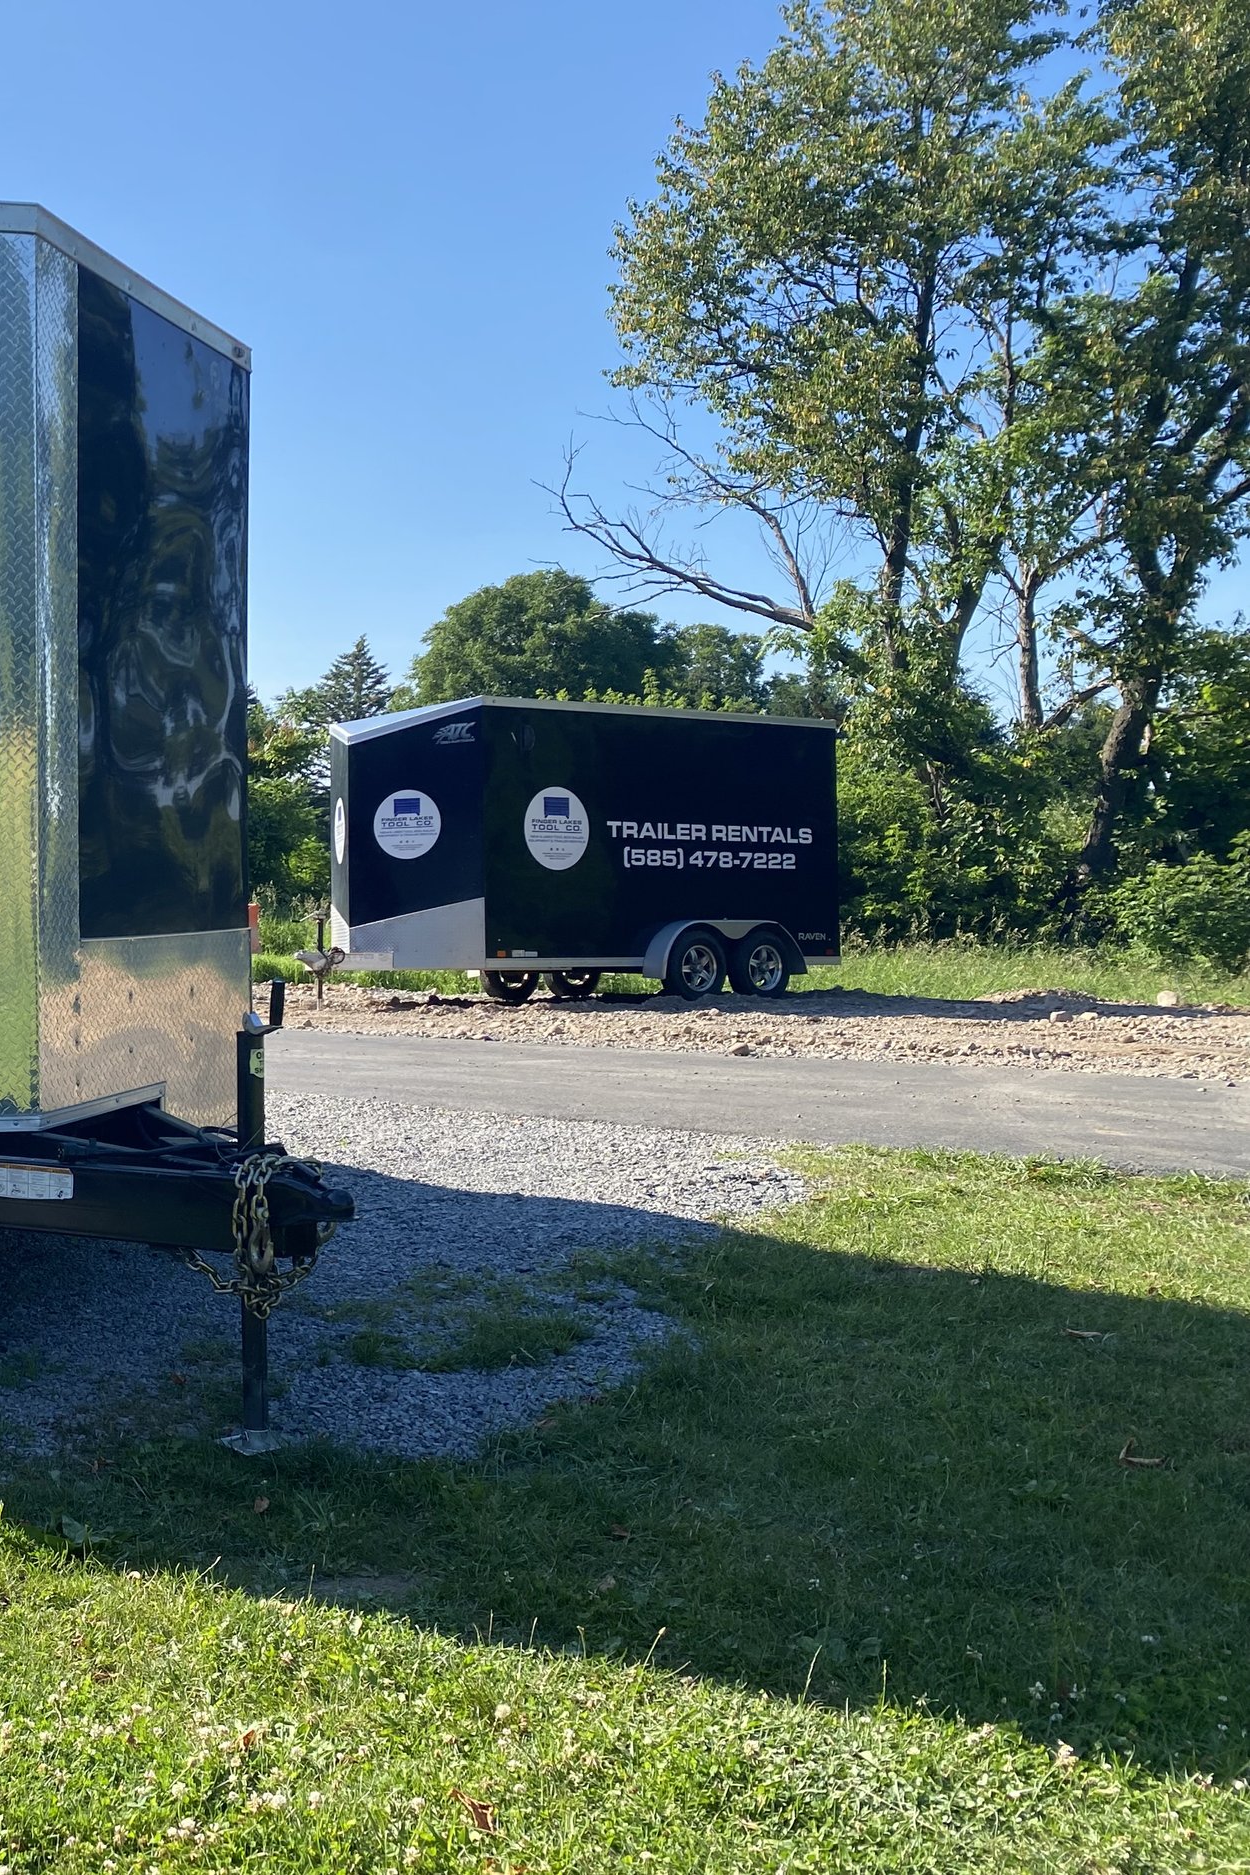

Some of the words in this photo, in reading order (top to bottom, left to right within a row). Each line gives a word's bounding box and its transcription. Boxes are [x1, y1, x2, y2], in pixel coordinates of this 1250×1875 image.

[606, 820, 706, 841] TRAILER
[711, 825, 813, 844] RENTALS
[623, 846, 684, 869] (585)
[689, 850, 796, 870] 478-7222
[798, 932, 826, 941] RAVEN
